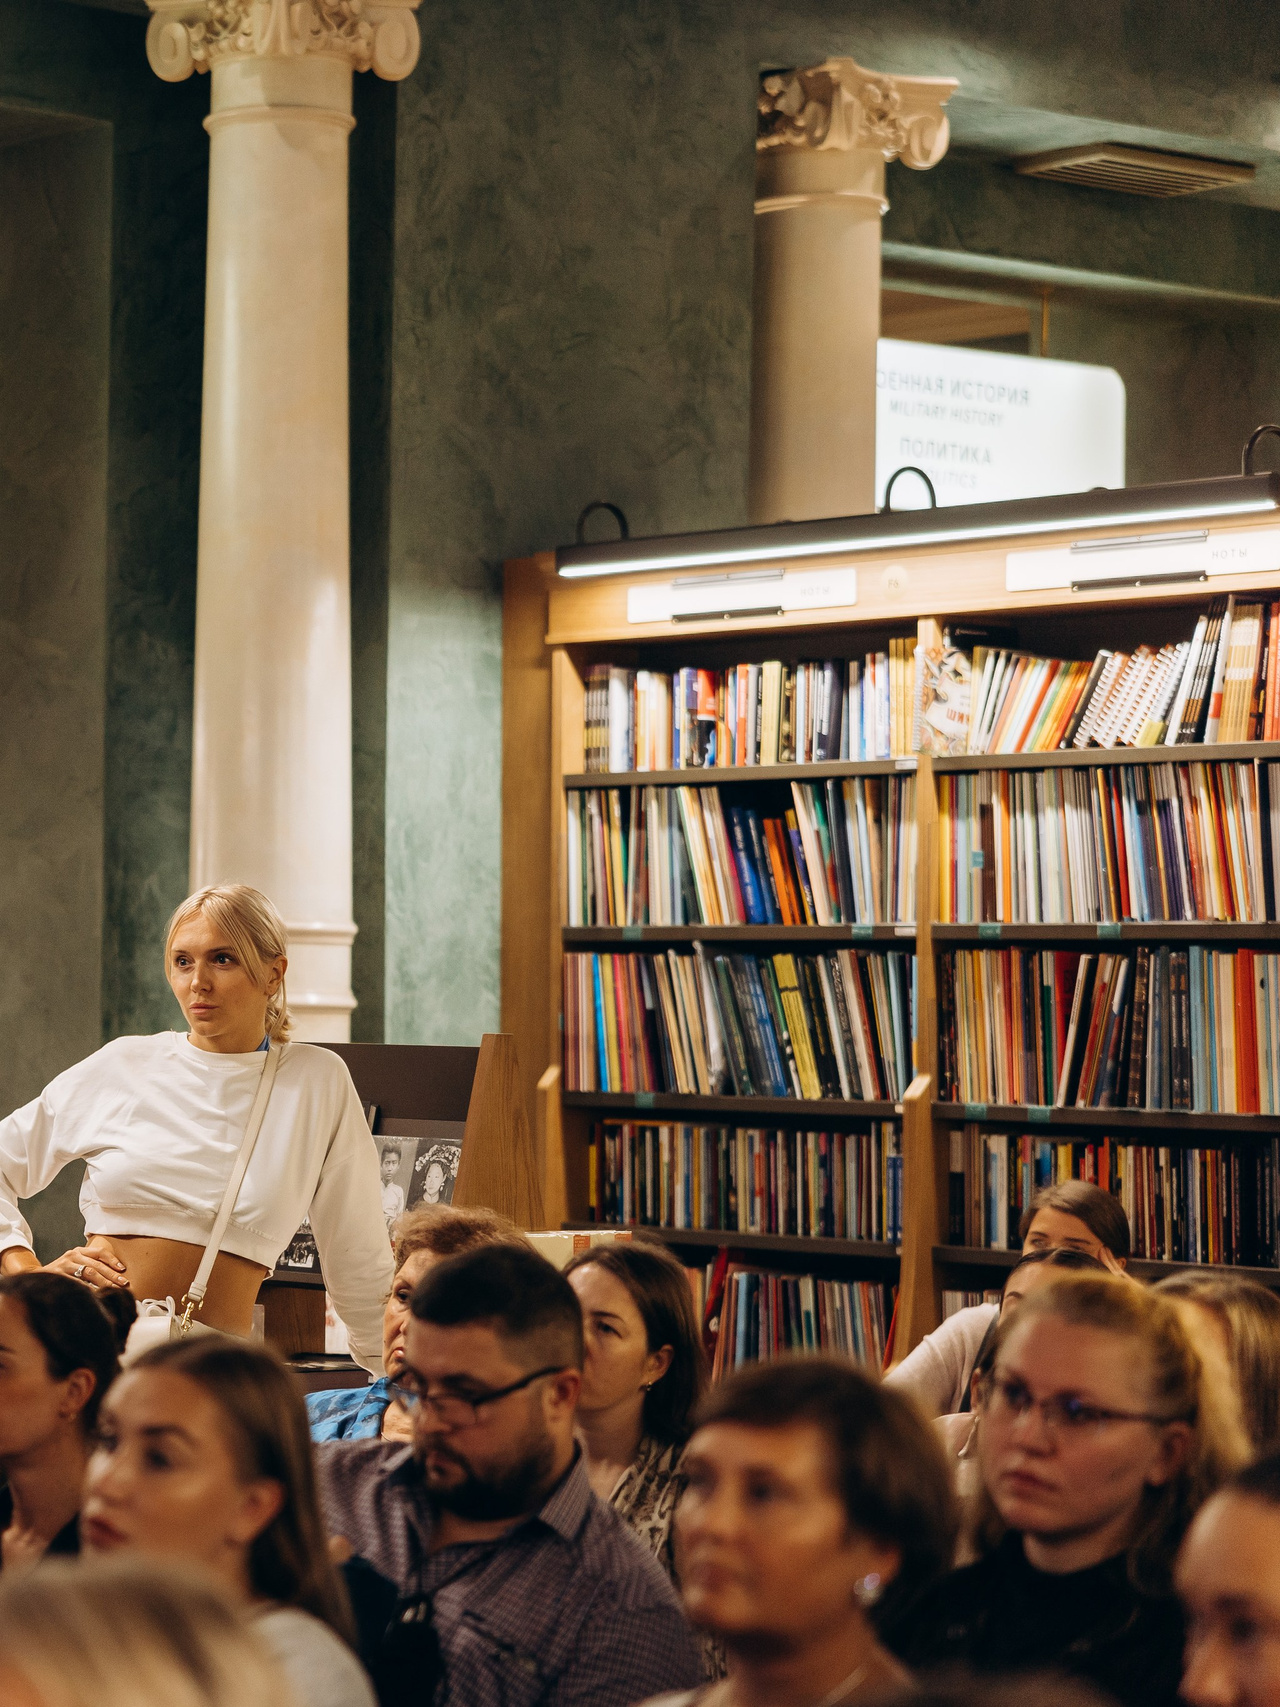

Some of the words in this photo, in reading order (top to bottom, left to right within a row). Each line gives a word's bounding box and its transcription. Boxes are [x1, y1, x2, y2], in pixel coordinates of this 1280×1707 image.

[877, 368, 944, 396] ОЕННАЯ
[950, 379, 1029, 406] ИСТОРИЯ
[889, 399, 949, 419] MILITARY
[950, 406, 1004, 427] HISTORY
[900, 436, 991, 466] ПОЛИТИКА
[1212, 548, 1247, 560] НОТЫ
